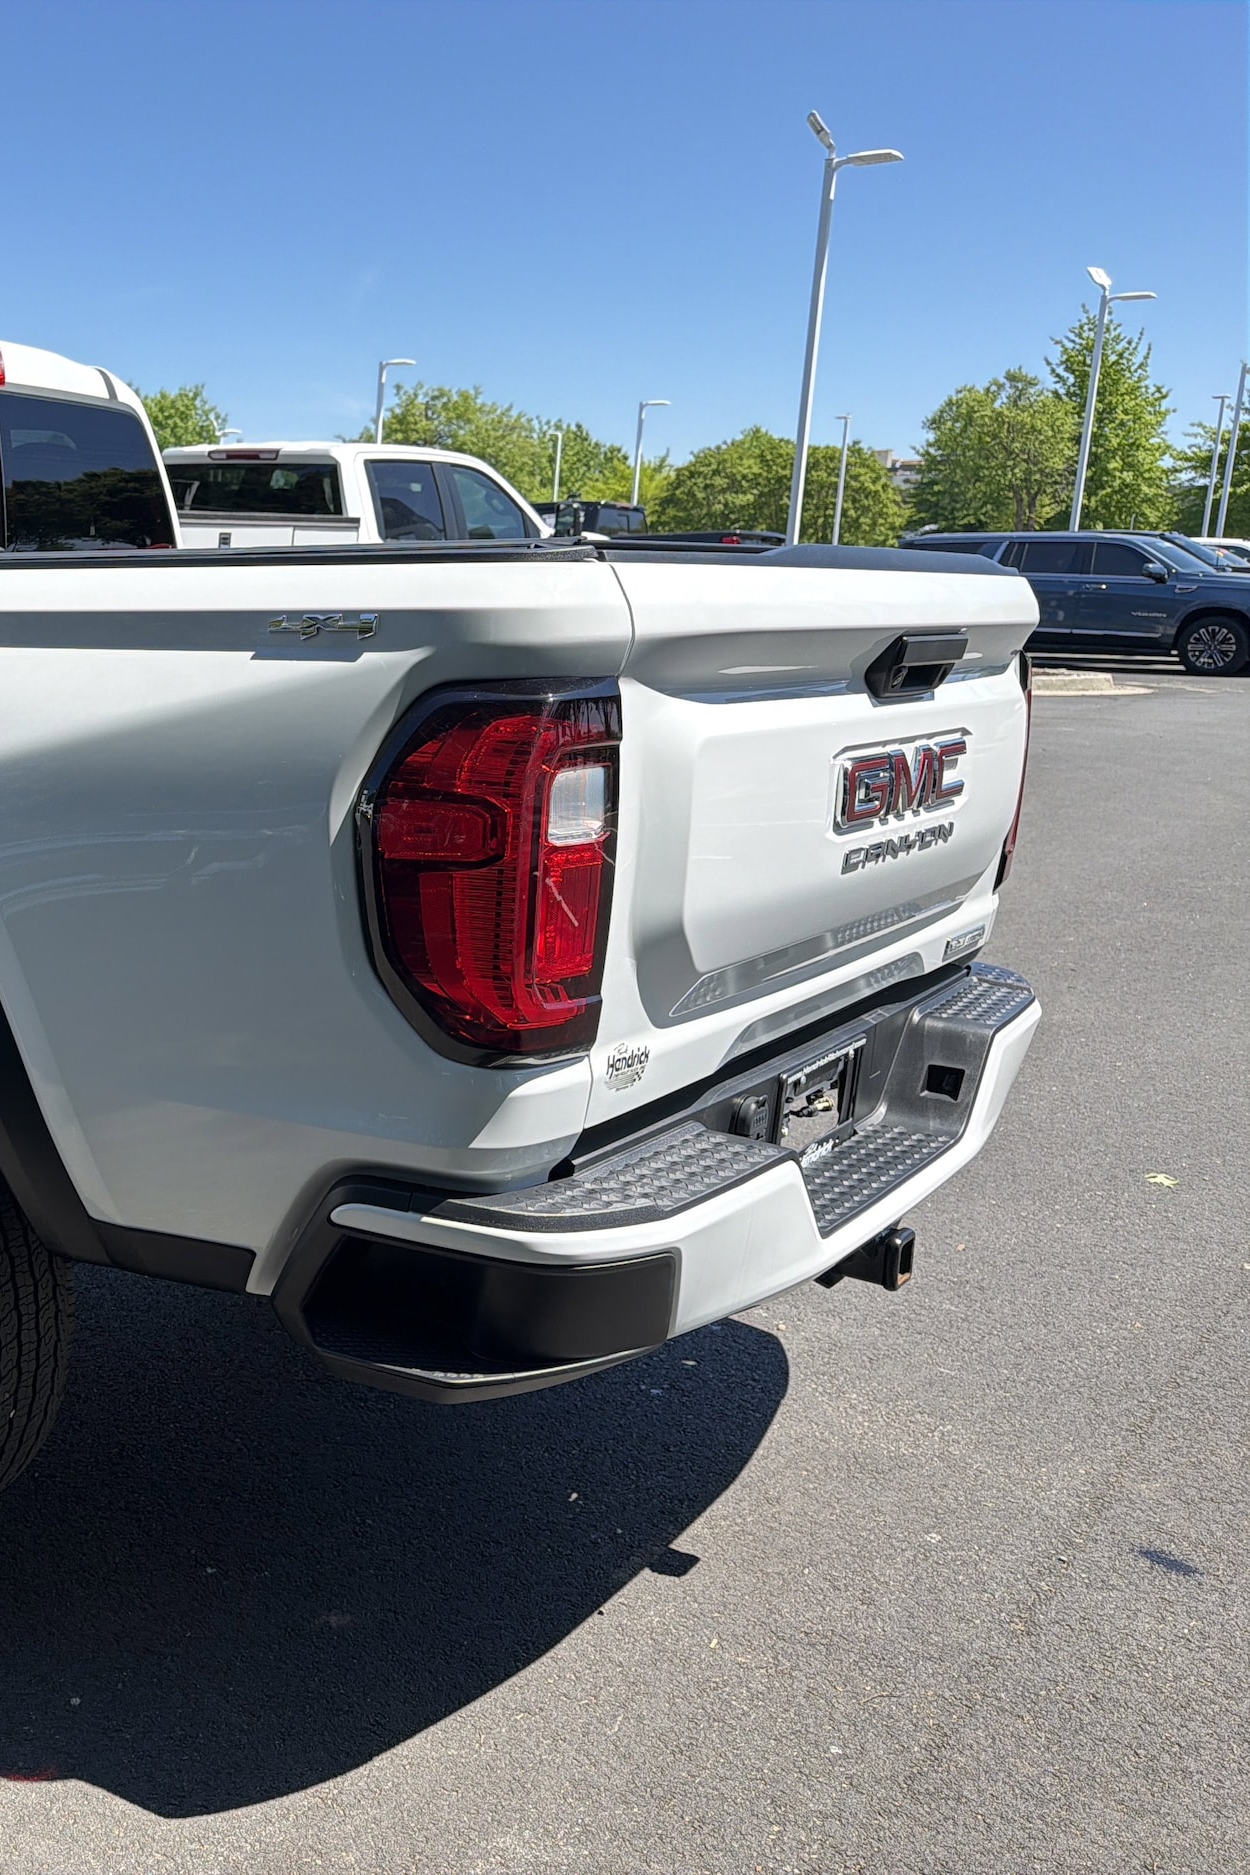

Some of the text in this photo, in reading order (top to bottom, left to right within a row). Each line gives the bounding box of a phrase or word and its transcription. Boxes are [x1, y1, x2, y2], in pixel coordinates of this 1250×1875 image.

[834, 737, 968, 830] GMC
[841, 821, 956, 875] CANYON
[606, 1045, 650, 1080] Hendrick
